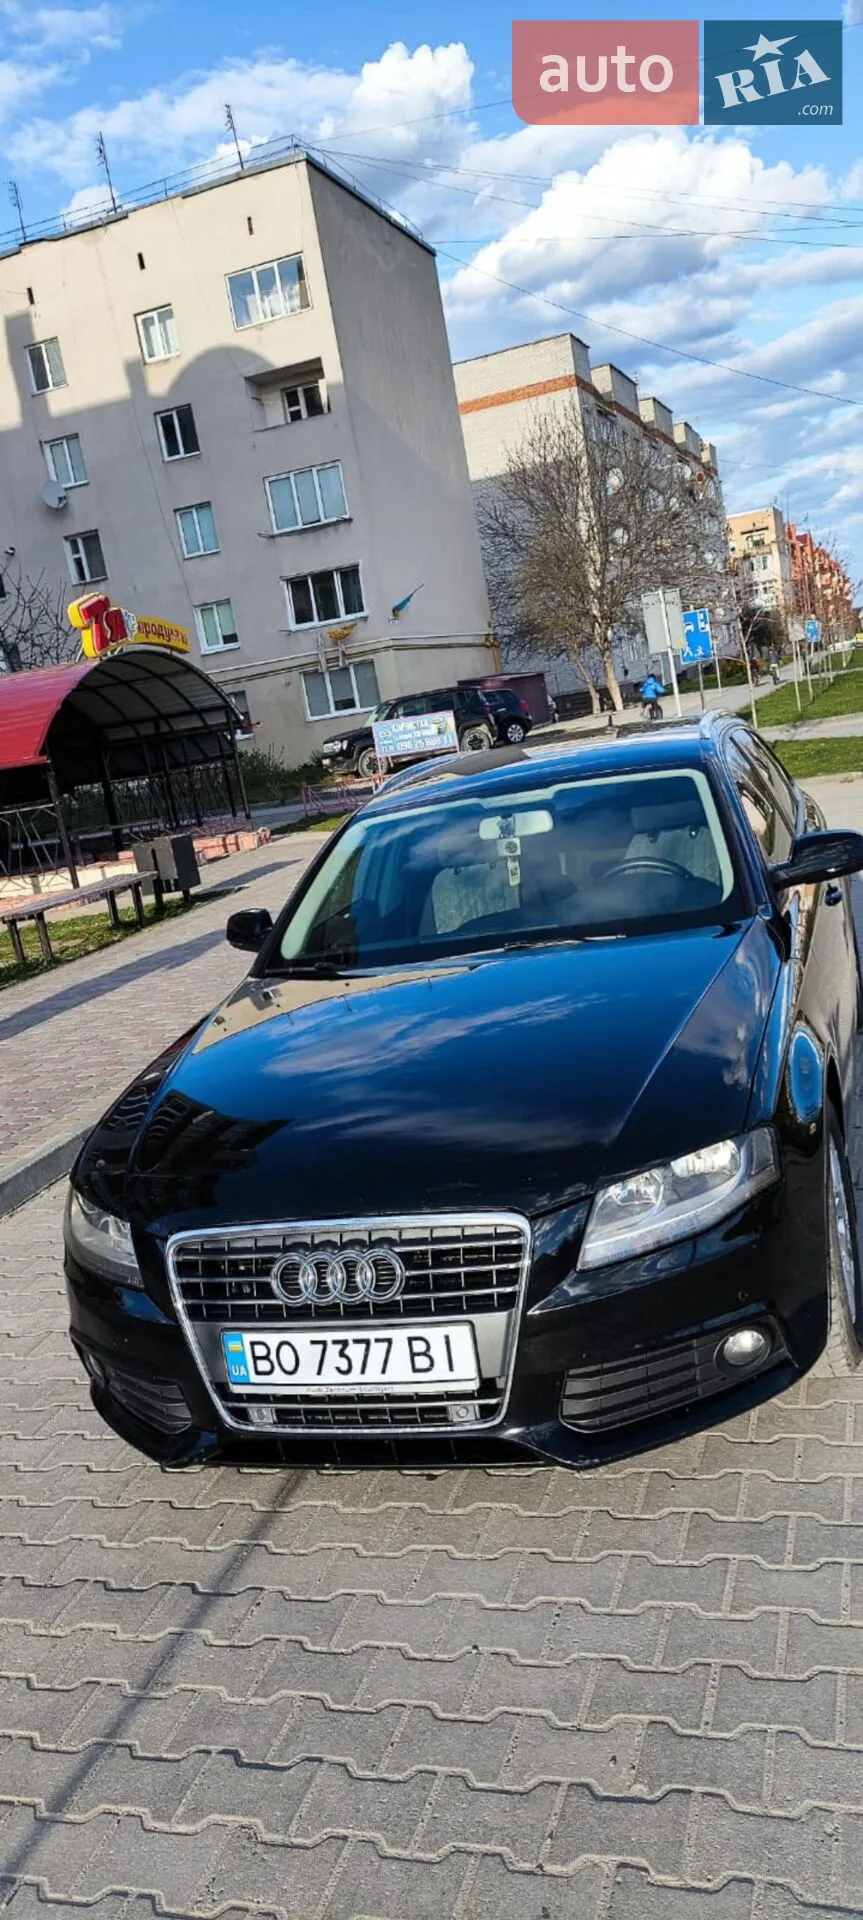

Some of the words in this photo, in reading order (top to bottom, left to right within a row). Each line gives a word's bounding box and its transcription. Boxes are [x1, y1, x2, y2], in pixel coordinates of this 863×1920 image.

[249, 1340, 300, 1376] BO
[309, 1337, 393, 1376] 7377
[232, 1365, 248, 1377] UA
